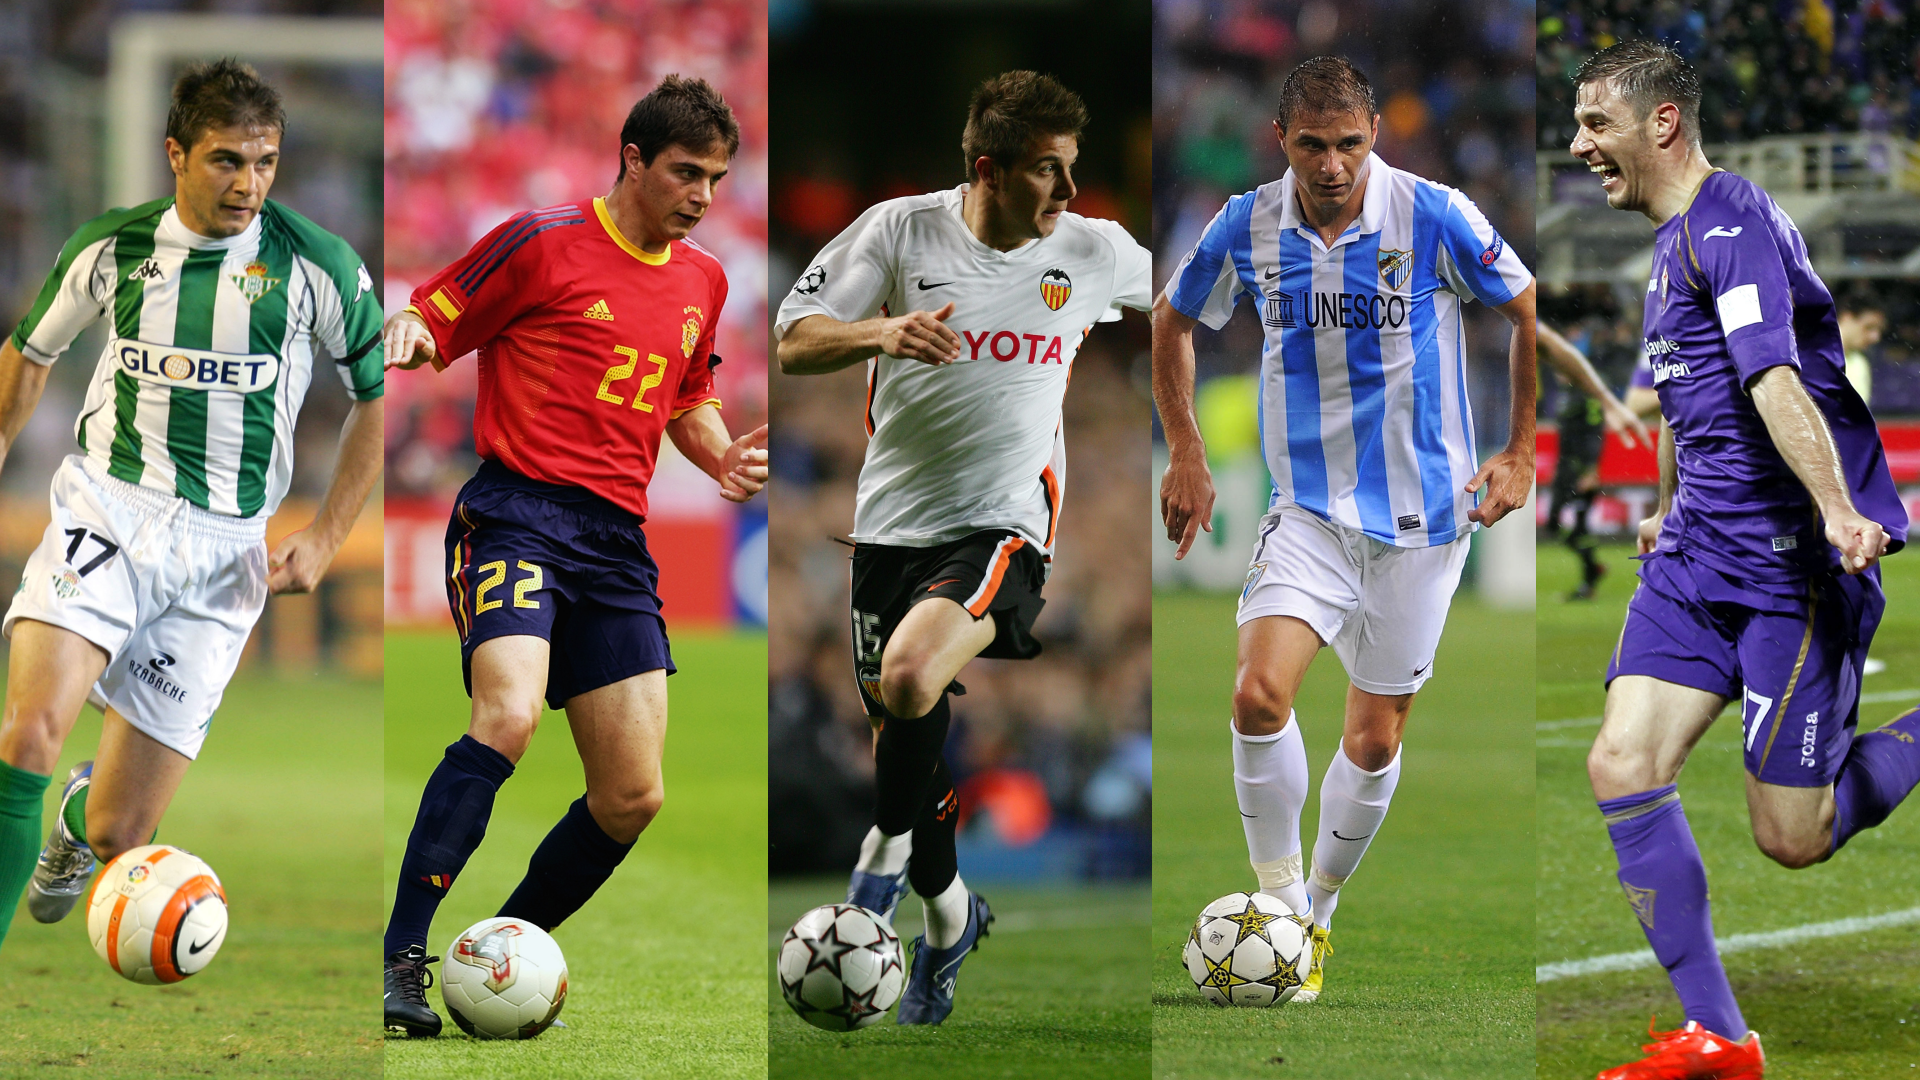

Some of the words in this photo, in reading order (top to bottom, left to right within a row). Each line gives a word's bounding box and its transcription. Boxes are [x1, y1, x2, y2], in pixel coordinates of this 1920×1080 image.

[583, 311, 615, 322] adidas
[1304, 292, 1405, 330] UNESCO
[120, 347, 267, 387] GLOBET
[952, 330, 1063, 364] YOTA
[595, 344, 668, 414] 22
[1651, 360, 1691, 384] hildren
[64, 527, 120, 579] 17
[475, 559, 543, 617] 22
[852, 607, 882, 664] 15
[128, 659, 188, 704] AZABACHE
